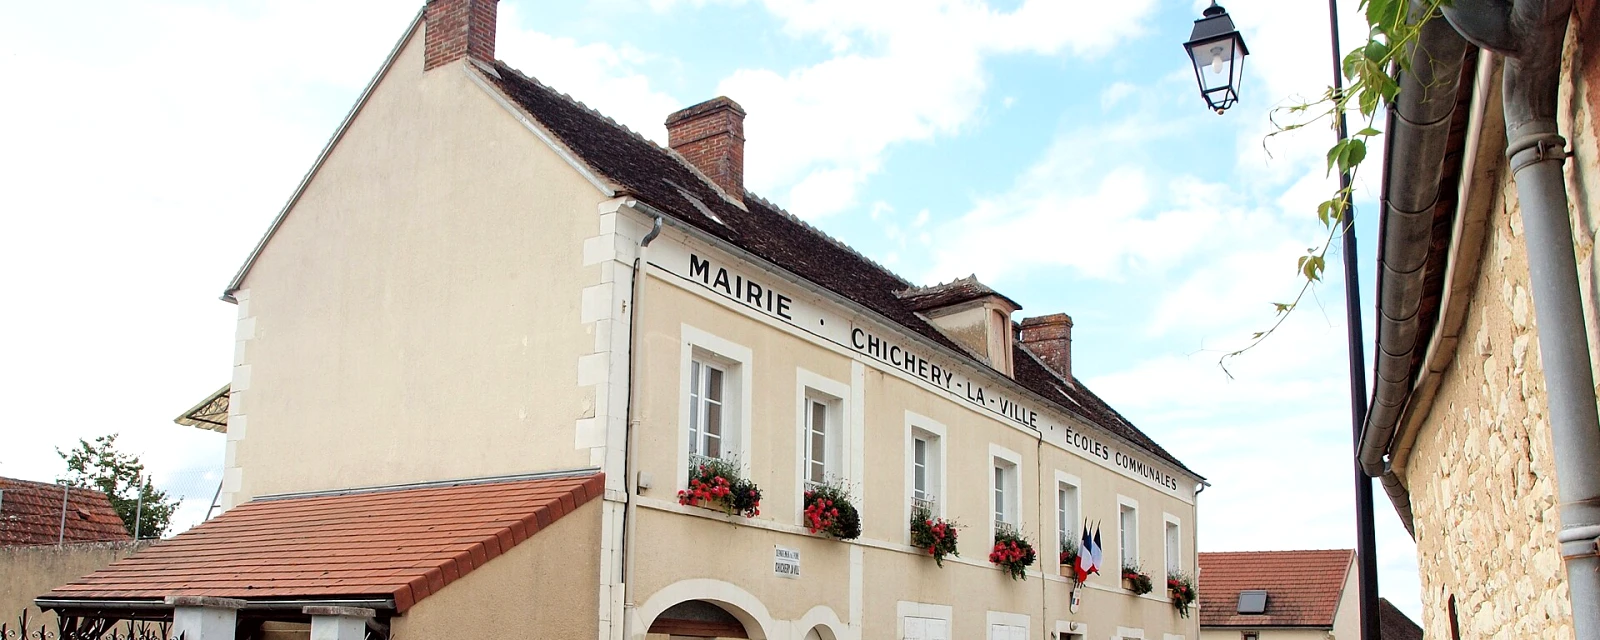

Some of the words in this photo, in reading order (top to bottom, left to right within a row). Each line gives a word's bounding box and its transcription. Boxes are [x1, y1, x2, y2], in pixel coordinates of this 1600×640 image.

[689, 253, 792, 320] MAIRIE
[1065, 426, 1109, 461] ÉCOLES
[1115, 452, 1177, 491] COMMUNALES
